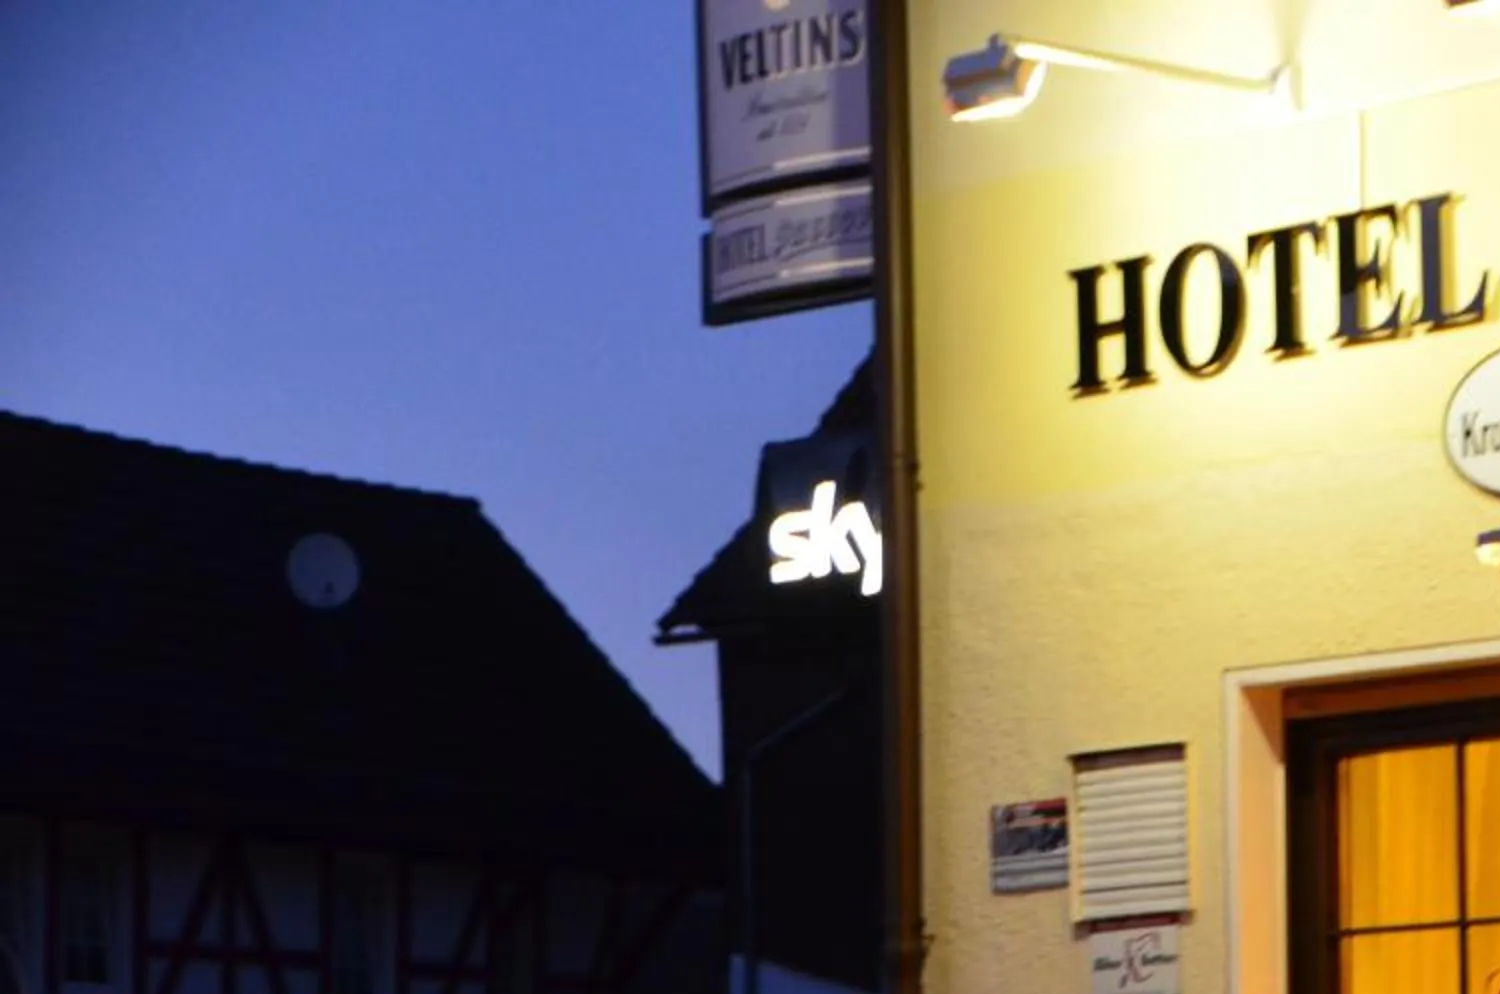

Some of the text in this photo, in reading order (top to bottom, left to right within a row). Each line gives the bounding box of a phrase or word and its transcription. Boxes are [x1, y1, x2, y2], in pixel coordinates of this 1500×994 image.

[718, 9, 863, 91] VELTINS
[1067, 192, 1488, 398] HOTEL
[768, 479, 883, 596] sky
